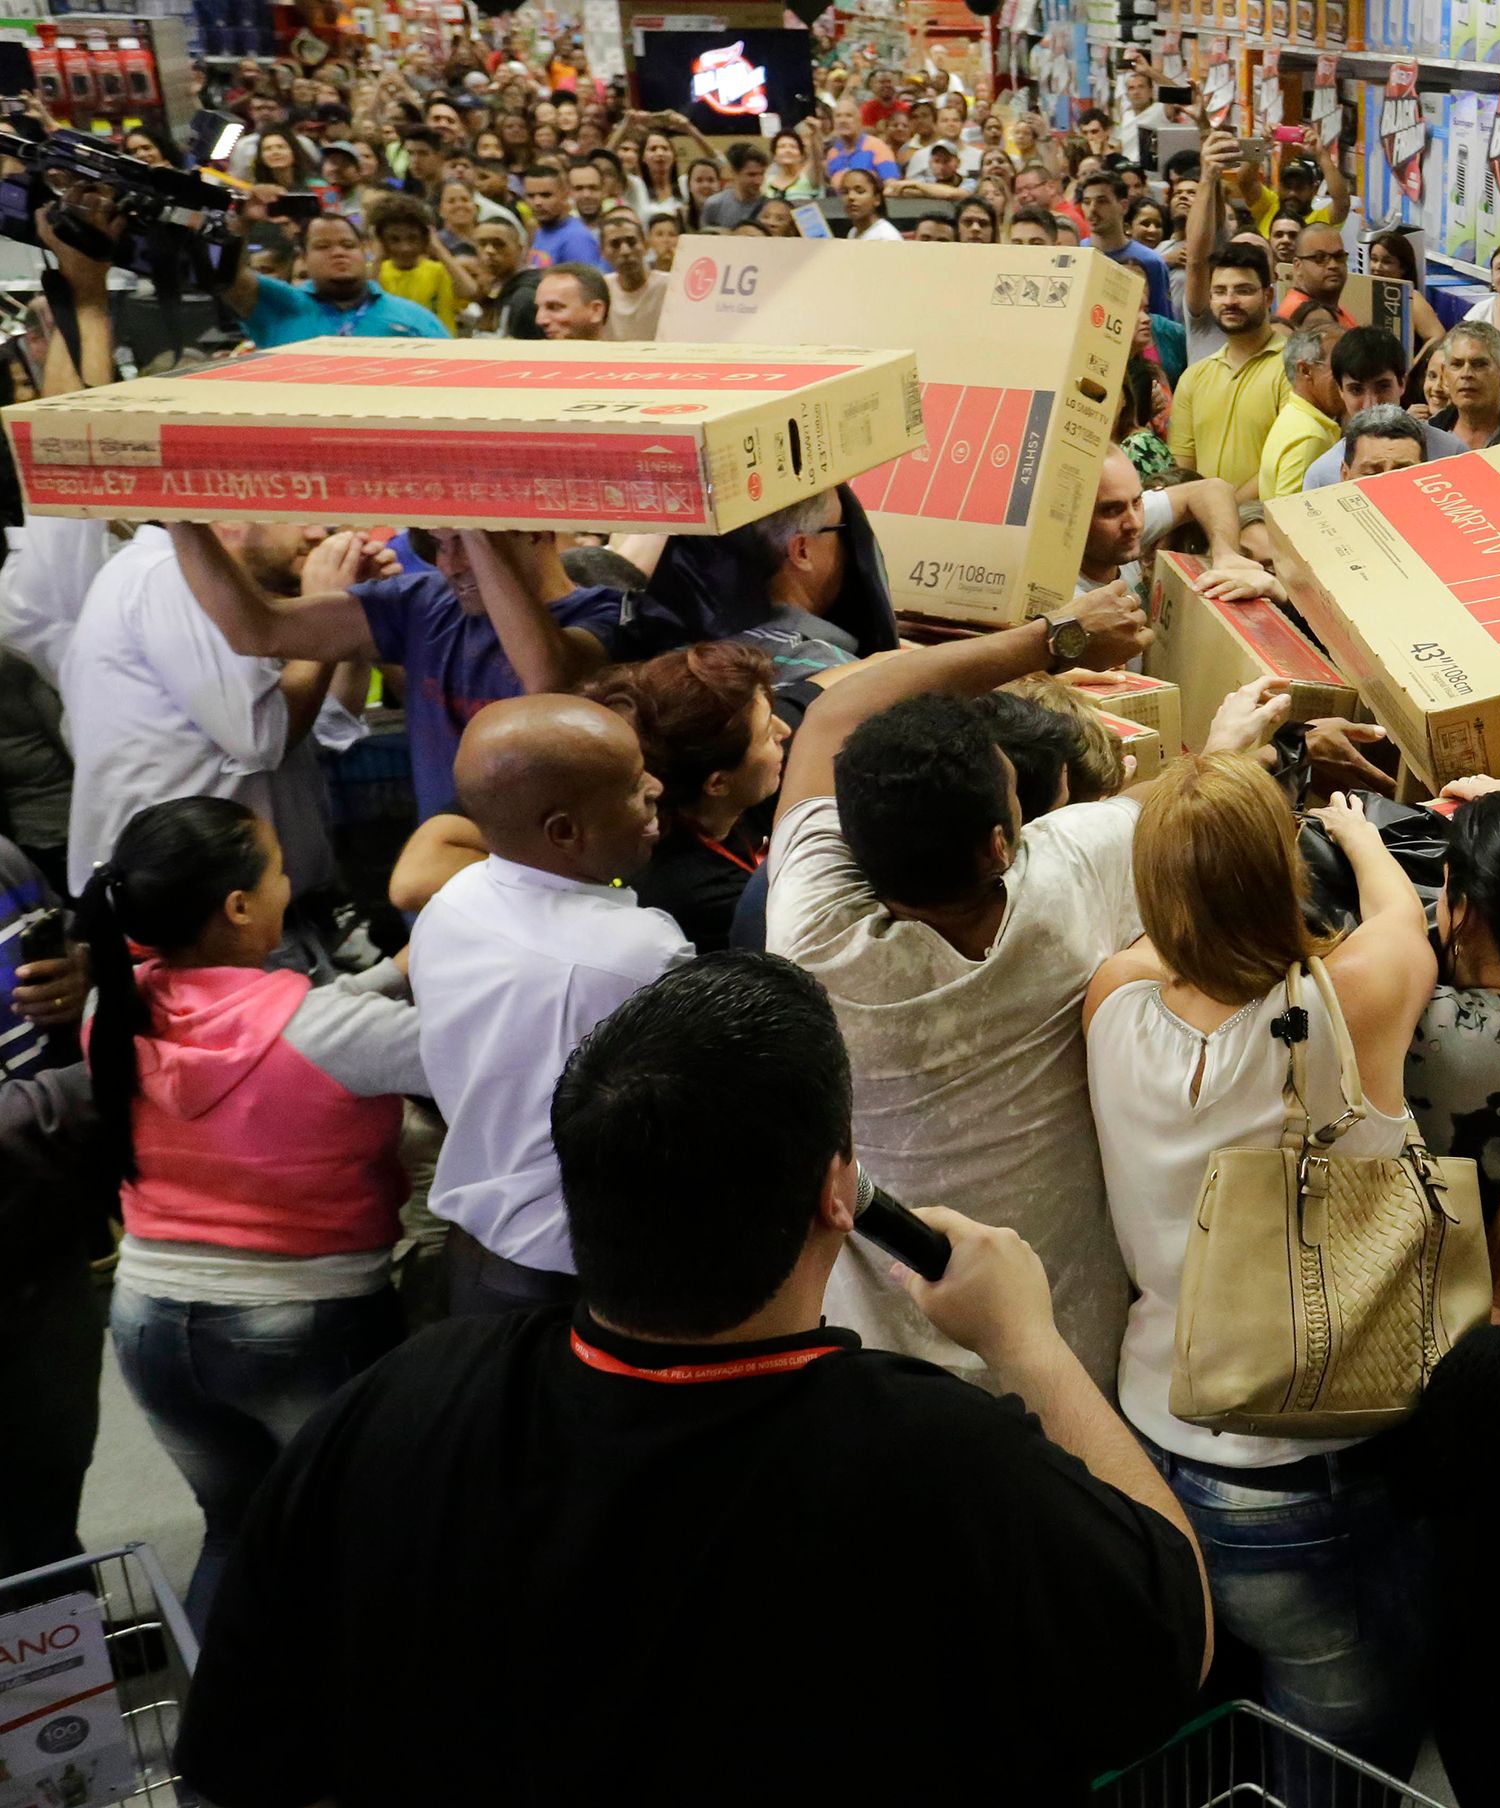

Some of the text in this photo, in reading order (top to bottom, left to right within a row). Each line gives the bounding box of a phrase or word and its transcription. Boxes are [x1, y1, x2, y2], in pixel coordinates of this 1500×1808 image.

[720, 264, 759, 296] LG
[1105, 314, 1123, 336] LG
[498, 370, 788, 382] LG SMART TV
[562, 403, 642, 413] LG
[1065, 396, 1077, 409] LG
[743, 435, 758, 469] LG
[1020, 431, 1041, 486] 43LH57
[161, 470, 330, 500] LG SMART TV
[1413, 473, 1454, 494] LG
[1430, 491, 1498, 534] SMART
[908, 560, 1007, 591] 43"/108cm
[1410, 641, 1474, 696] 43"/108cm
[670, 1370, 693, 1380] PELA
[694, 1365, 744, 1379] SATISFAÇÃO
[745, 1363, 756, 1372] DE
[758, 1358, 788, 1370] NOSSOS
